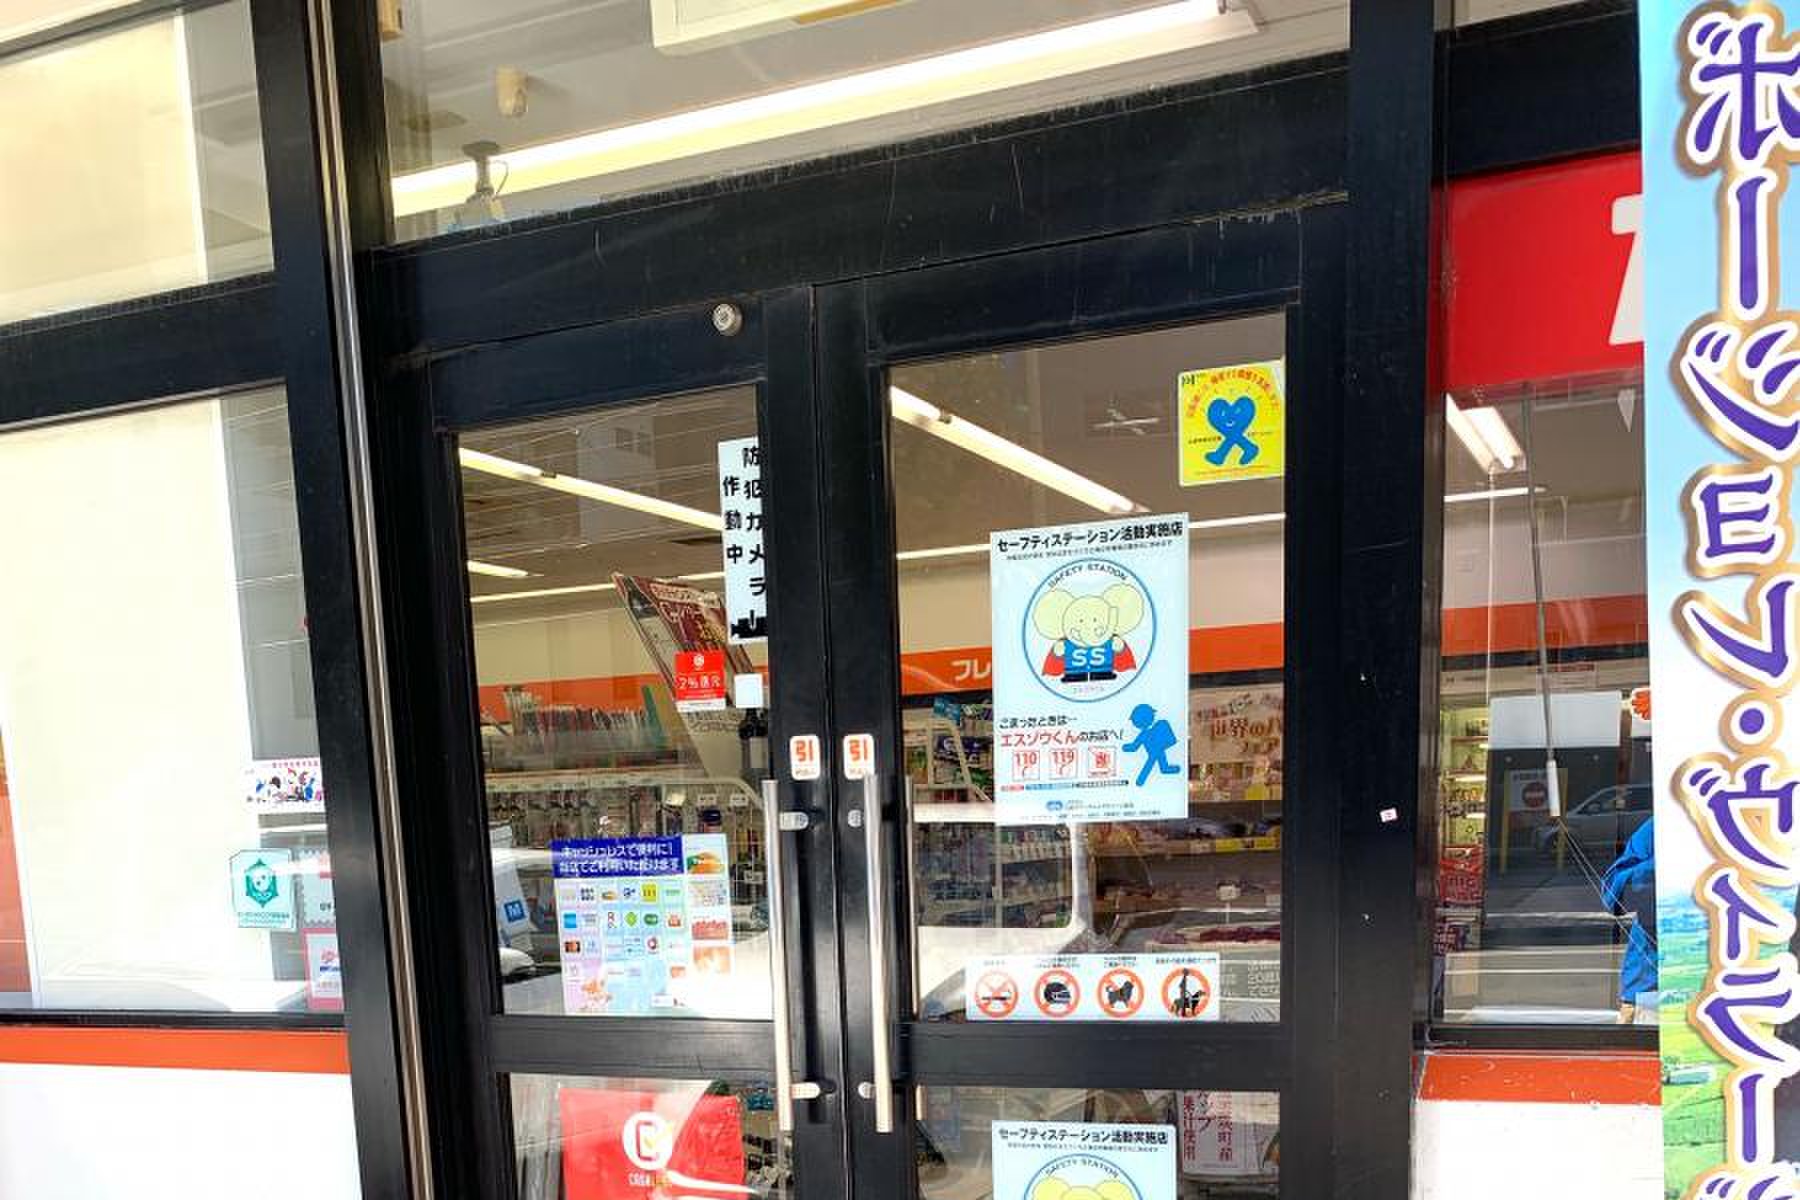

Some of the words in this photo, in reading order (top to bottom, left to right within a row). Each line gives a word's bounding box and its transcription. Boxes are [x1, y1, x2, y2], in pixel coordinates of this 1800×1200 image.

[723, 476, 743, 564] 作動中
[998, 521, 1183, 552] セーフティステーション活動実施店
[1048, 564, 1083, 588] SAFETY
[1087, 563, 1128, 581] STATION
[1071, 647, 1105, 666] SS
[796, 740, 814, 762] 引
[849, 739, 868, 762] 引
[1014, 752, 1037, 766] 110
[998, 1127, 1169, 1145] セーフティステーション活動実施店
